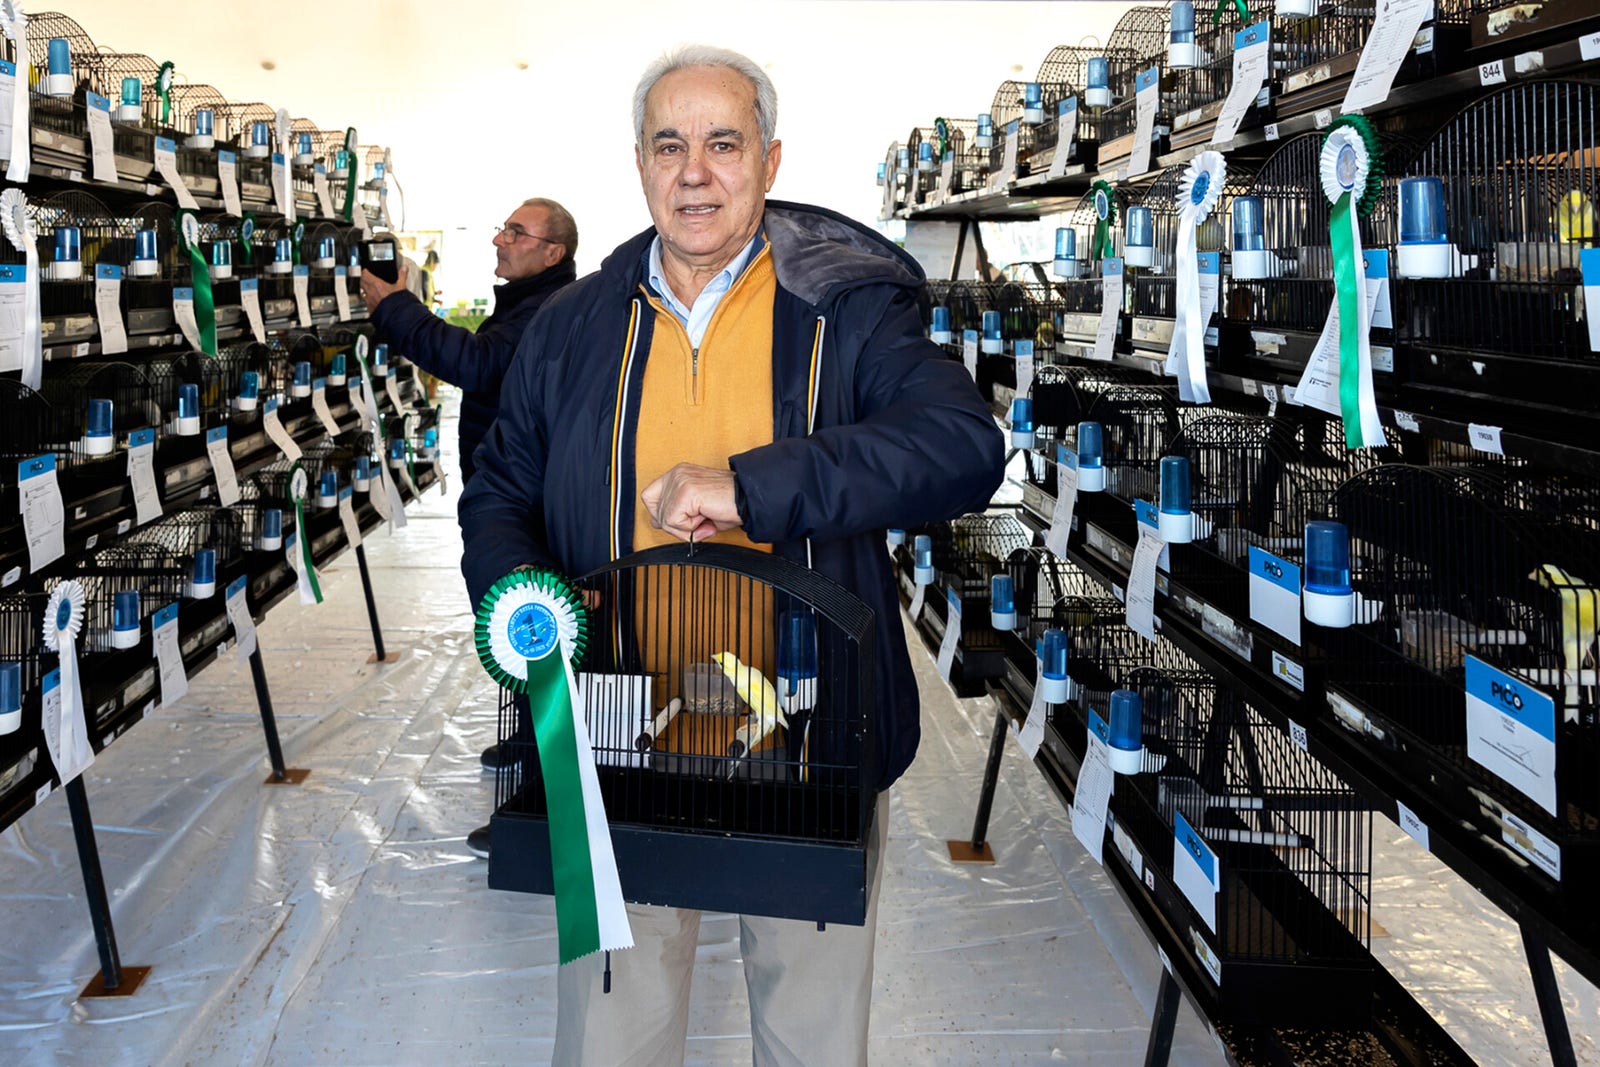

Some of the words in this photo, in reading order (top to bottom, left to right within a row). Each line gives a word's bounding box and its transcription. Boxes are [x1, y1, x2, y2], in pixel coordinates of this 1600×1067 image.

[1482, 64, 1500, 79] 844
[1264, 561, 1283, 578] PICO
[1491, 681, 1524, 711] PICO
